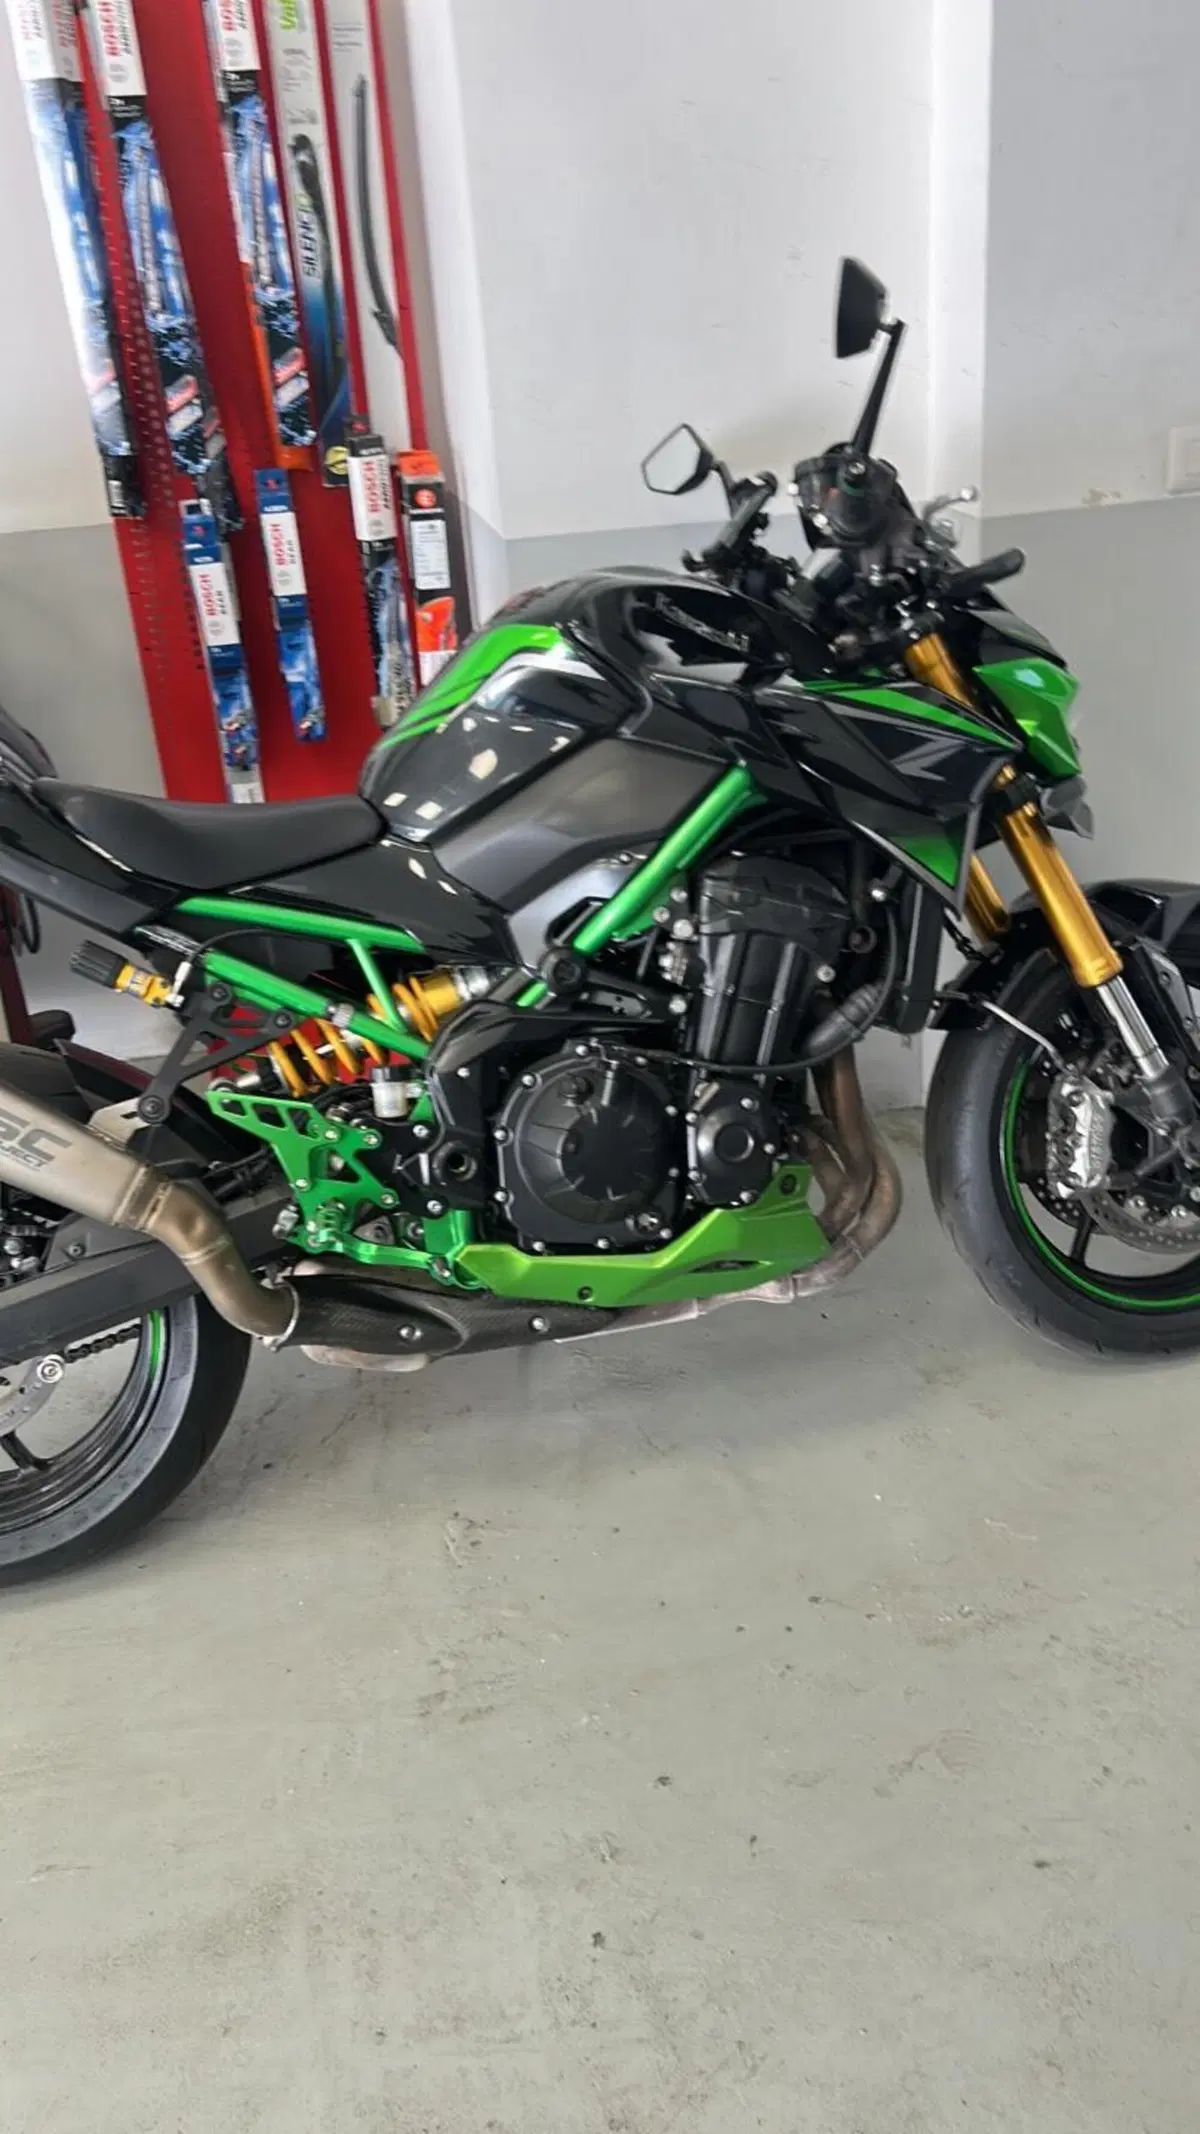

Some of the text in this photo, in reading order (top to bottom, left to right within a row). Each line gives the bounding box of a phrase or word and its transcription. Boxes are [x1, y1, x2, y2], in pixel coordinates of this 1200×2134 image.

[361, 461, 381, 513] BOSCH
[269, 523, 286, 566] BOSCH
[199, 574, 217, 616] BOSCH
